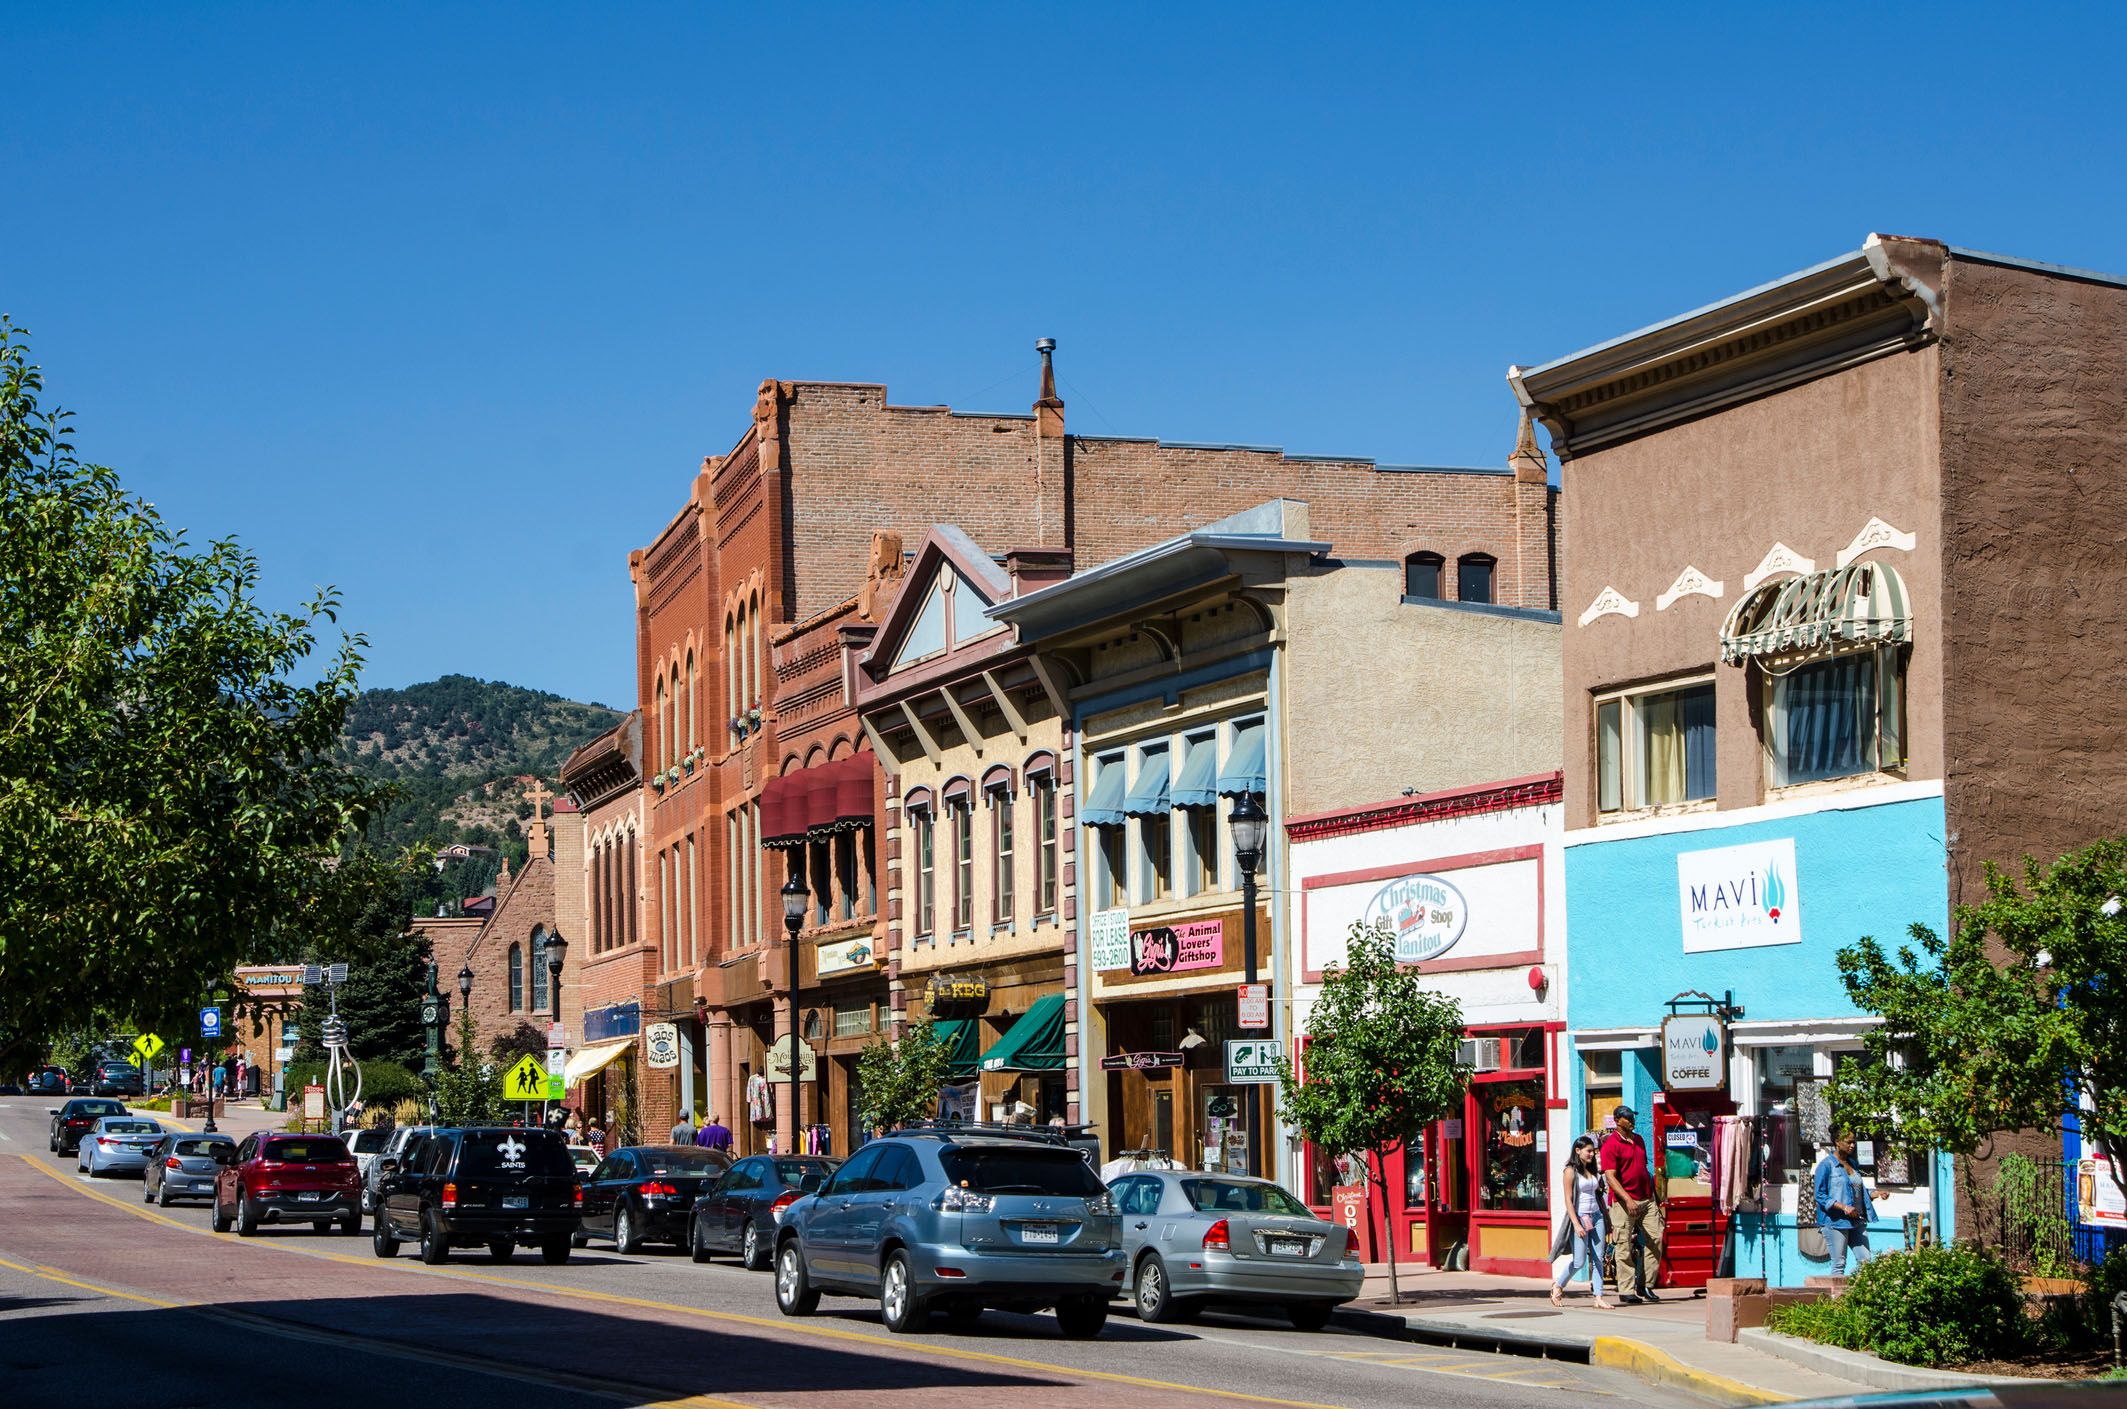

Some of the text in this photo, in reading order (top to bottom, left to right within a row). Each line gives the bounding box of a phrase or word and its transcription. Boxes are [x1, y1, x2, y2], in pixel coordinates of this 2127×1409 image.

[1380, 881, 1446, 913] Christmas
[1092, 914, 1107, 926] OFFICE
[1110, 911, 1126, 925] STUDIO
[1376, 910, 1453, 930] Gift Shop
[1188, 923, 1220, 938] Animal
[1092, 927, 1127, 948] FOR LEASE
[1181, 937, 1214, 950] Lovers'
[1093, 948, 1128, 967] 593-2600
[1178, 950, 1216, 963] Giftshop
[246, 975, 292, 985] MANITOU
[951, 983, 986, 998] KEG
[1239, 987, 1248, 998] NO
[768, 1051, 814, 1064] Mouains
[1233, 1067, 1247, 1076] PAY
[1248, 1066, 1259, 1075] TO
[1672, 1069, 1710, 1079] COFFEE
[1668, 1133, 1686, 1141] CLOSED
[501, 1161, 526, 1169] SAINTS
